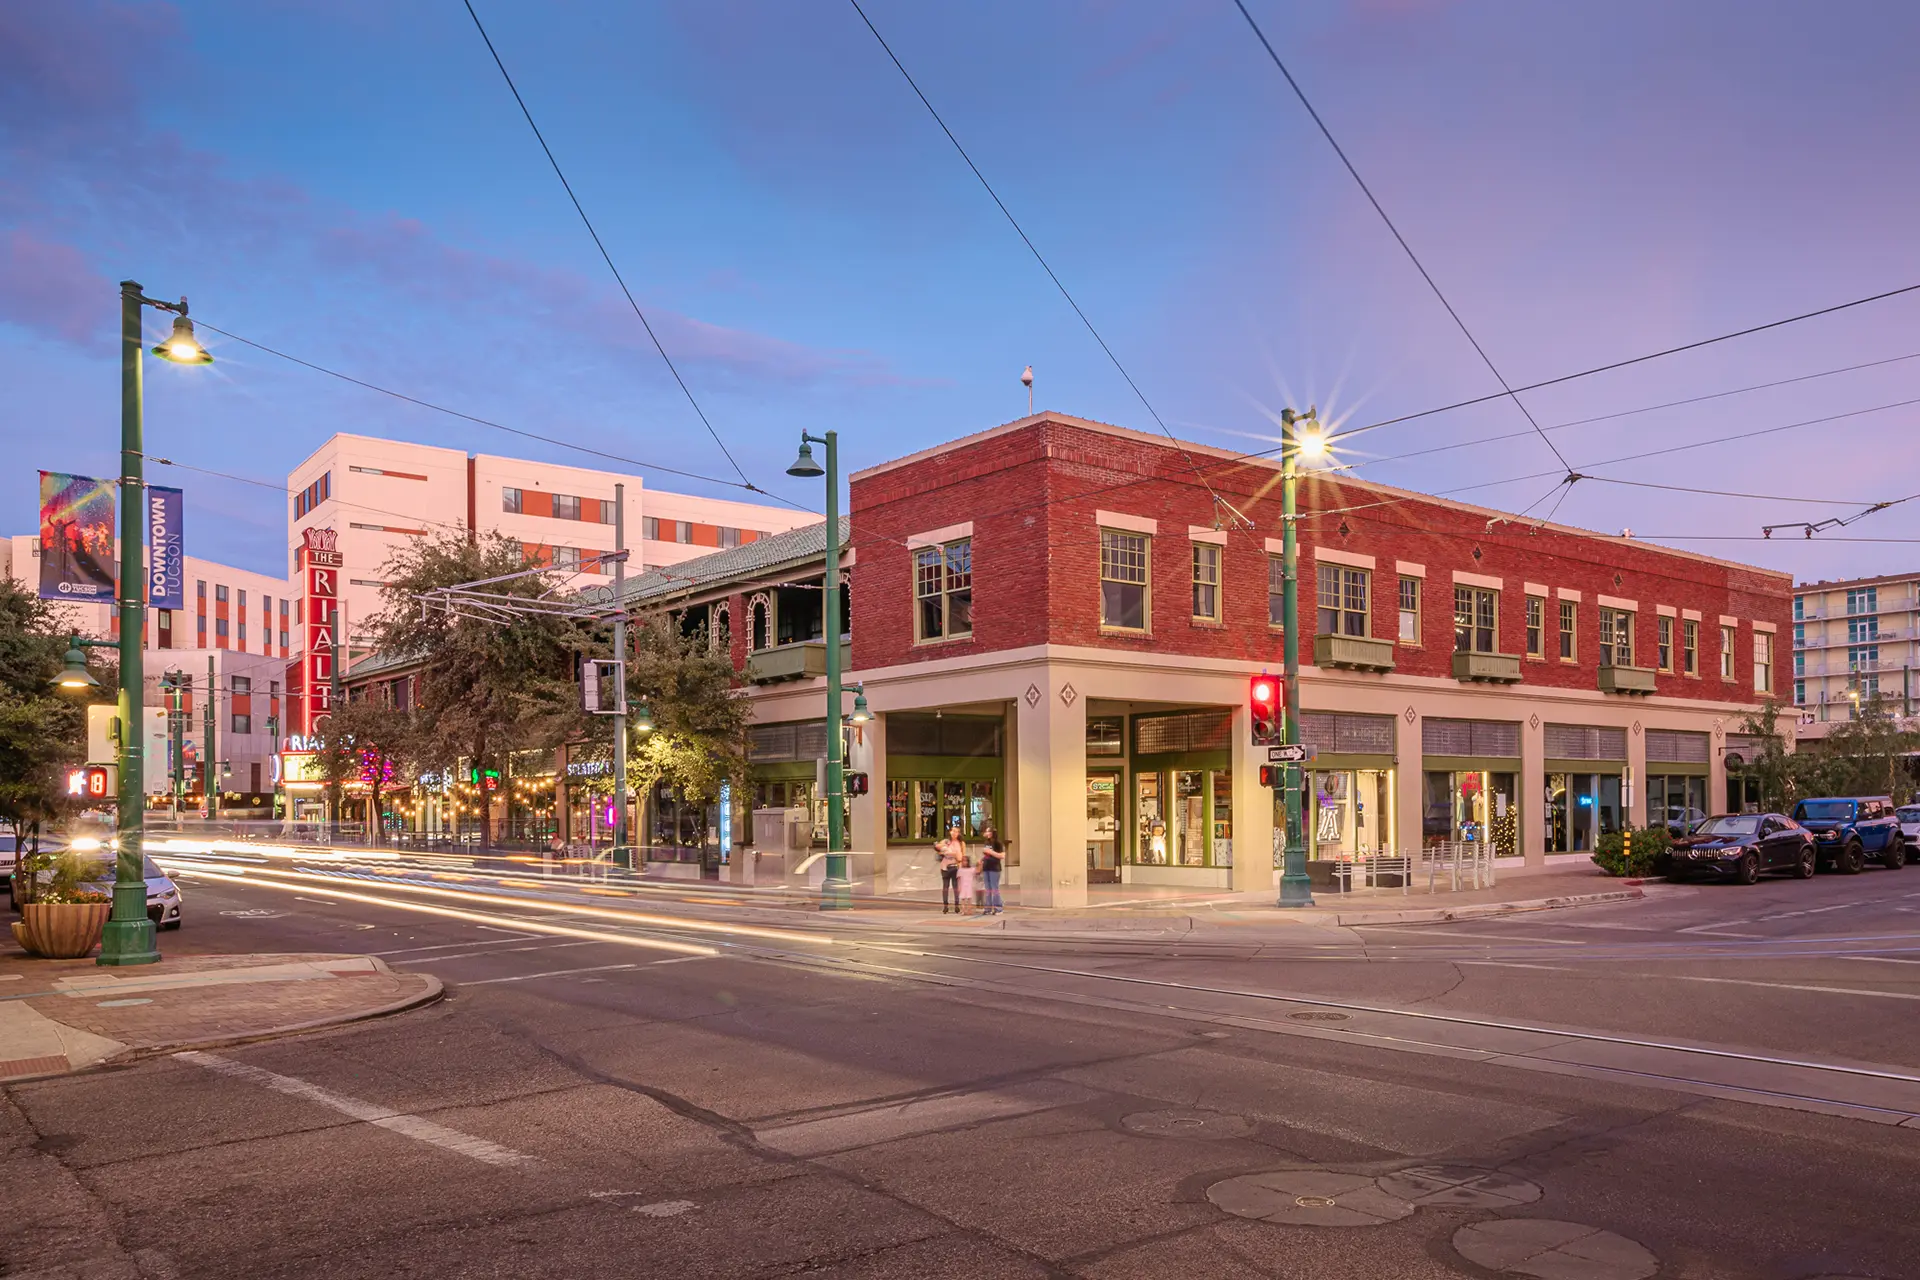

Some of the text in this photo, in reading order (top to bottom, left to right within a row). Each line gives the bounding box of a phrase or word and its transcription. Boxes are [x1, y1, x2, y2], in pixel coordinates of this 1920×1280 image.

[151, 497, 166, 597] DOWNTOWN
[167, 533, 180, 597] TUCSON
[314, 552, 333, 563] THE
[90, 774, 103, 793] 18
